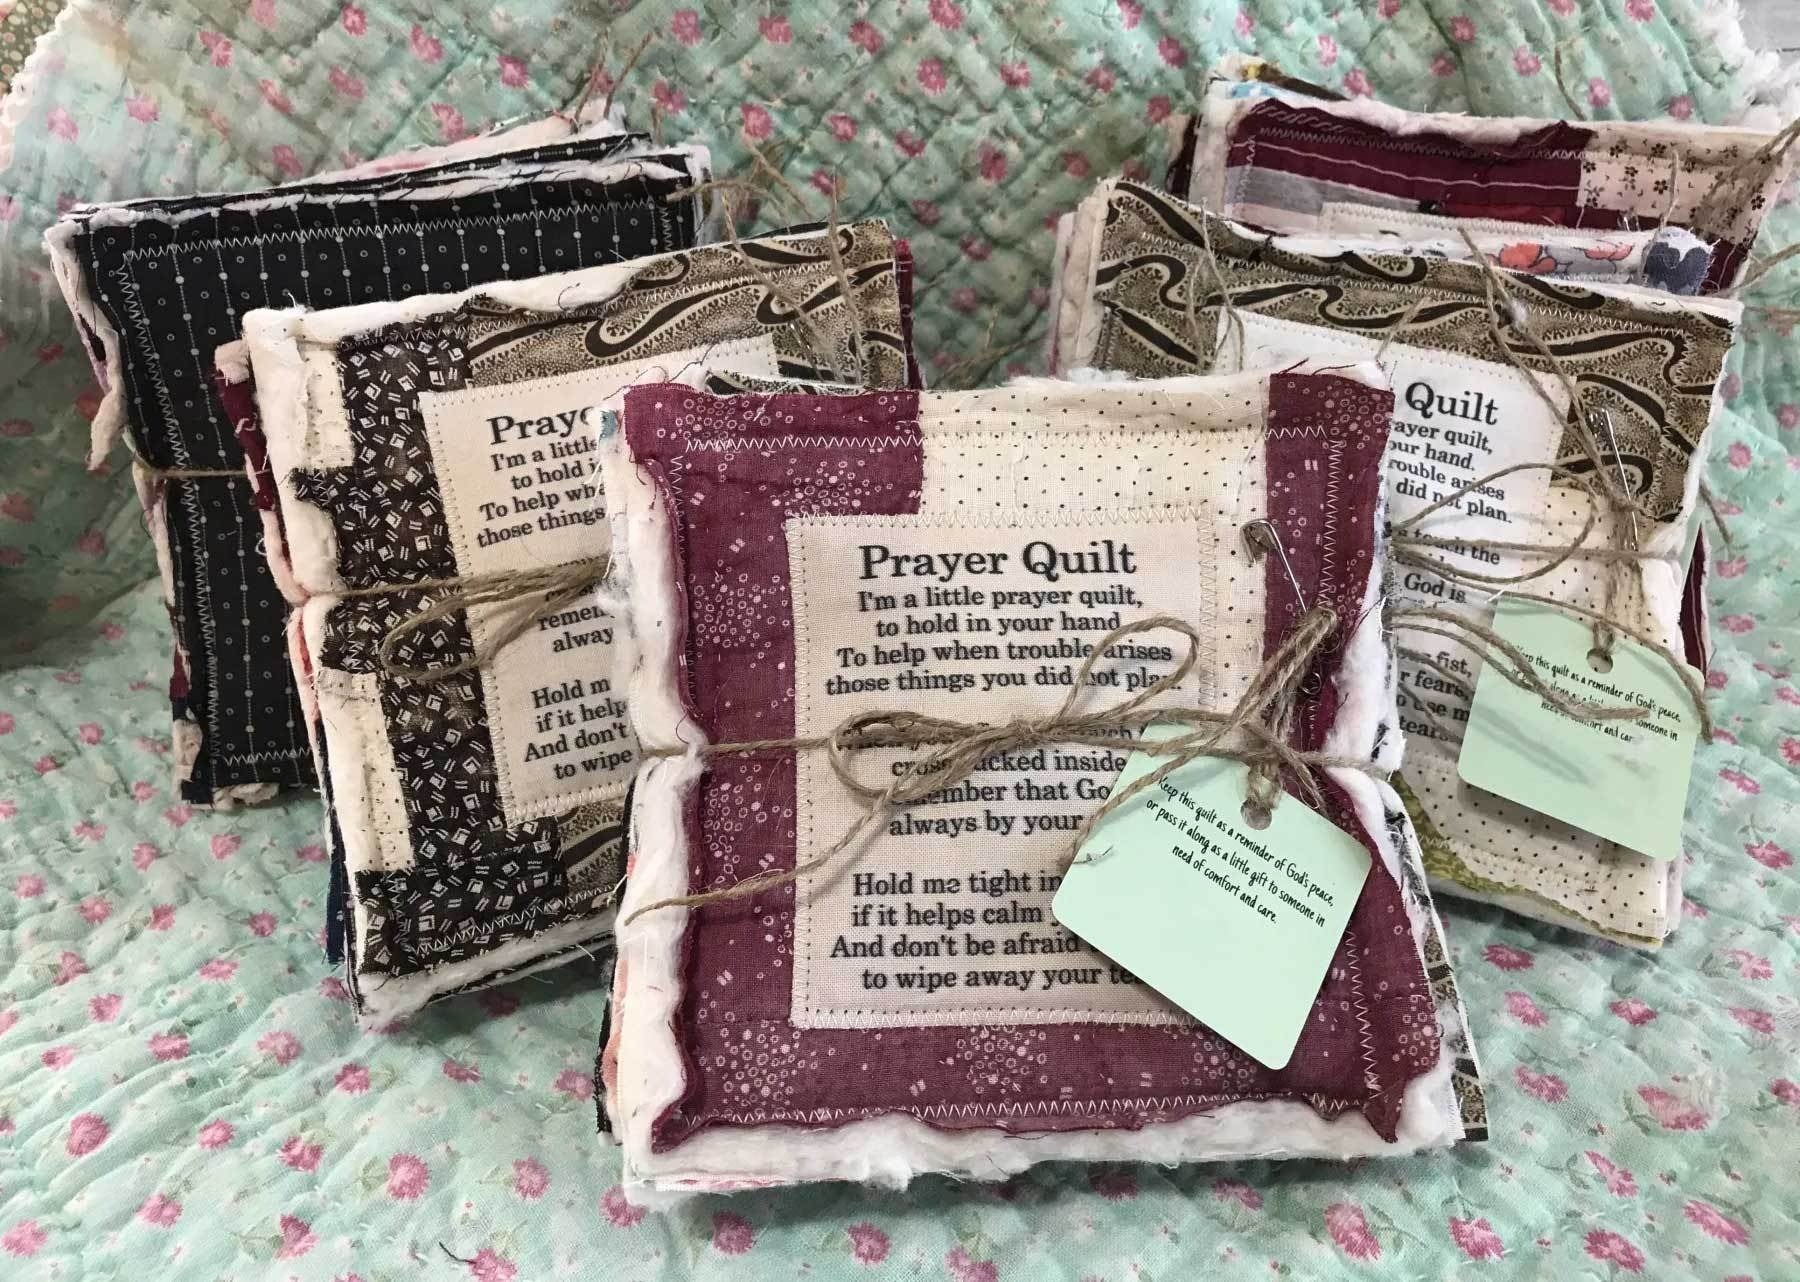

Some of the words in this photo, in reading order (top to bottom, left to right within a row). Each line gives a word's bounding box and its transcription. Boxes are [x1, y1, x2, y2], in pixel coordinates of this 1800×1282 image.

[1405, 382, 1499, 425] Quilt
[1393, 421, 1440, 439] ayer
[1444, 430, 1493, 454] quilt,
[491, 453, 526, 472] I'm
[532, 450, 545, 462] a
[1387, 459, 1446, 484] rouble
[1424, 443, 1475, 471] hand.
[511, 475, 532, 490] to
[536, 460, 584, 483] hold
[480, 502, 508, 521] To
[512, 491, 559, 513] help
[1396, 477, 1427, 499] did
[1466, 499, 1512, 523] plan.
[477, 522, 533, 547] those
[537, 507, 605, 531] things
[859, 544, 1007, 582] Prayer
[1023, 540, 1137, 582] Quilt
[858, 590, 895, 612] I'm
[904, 592, 918, 608] a
[926, 586, 983, 607] little
[991, 588, 1071, 609] prayer
[1079, 585, 1143, 608] quilt,
[1404, 573, 1445, 596] God
[1449, 583, 1466, 603] is
[553, 627, 614, 653] alway
[876, 618, 899, 637] to
[907, 614, 957, 634] hold
[967, 614, 990, 632] in
[998, 618, 1053, 637] your
[837, 647, 866, 668] To
[874, 643, 925, 667] help
[933, 640, 999, 660] when
[1007, 637, 1093, 660] trouble
[1104, 639, 1172, 660] arises
[531, 679, 584, 709] Hold
[826, 676, 889, 695] those
[898, 669, 975, 692] things
[981, 673, 1026, 691] you
[1034, 666, 1073, 686] did
[1536, 656, 1550, 670] this
[1551, 665, 1570, 678] quilt
[1571, 673, 1580, 681] as
[1588, 679, 1623, 698] reminder
[1625, 692, 1634, 702] of
[536, 712, 552, 733] if
[558, 709, 576, 727] it
[579, 697, 627, 722] help
[525, 734, 570, 762] And
[574, 722, 628, 749] don't
[1604, 725, 1618, 738] and
[1670, 731, 1678, 741] in
[553, 763, 576, 779] to
[581, 749, 633, 772] wipe
[1054, 749, 1127, 772] inside
[1014, 779, 1069, 800] that
[1076, 777, 1111, 800] Go
[889, 813, 978, 838] always
[983, 809, 1015, 833] by
[1023, 814, 1083, 834] your
[1158, 777, 1178, 802] Keep
[1178, 791, 1196, 810] this
[1196, 807, 1217, 822] quilt
[1216, 819, 1227, 832] as
[1228, 826, 1234, 837] a
[1234, 832, 1274, 862] reminder
[1274, 858, 1288, 871] of
[1286, 863, 1310, 888] God's
[1307, 883, 1334, 907] peace,
[1146, 799, 1158, 810] or
[1156, 807, 1177, 826] pass
[1178, 819, 1188, 831] it
[1187, 826, 1210, 854] along
[1211, 844, 1222, 856] as
[1222, 852, 1228, 861] a
[1230, 851, 1250, 875] little
[1249, 870, 1268, 886] gift
[1269, 880, 1278, 894] to
[1279, 890, 1314, 920] someone
[1316, 911, 1325, 927] in
[853, 873, 913, 897] Hold
[922, 878, 961, 894] me
[968, 870, 1032, 897] tight
[1172, 845, 1192, 864] need
[1193, 858, 1206, 872] of
[1204, 867, 1240, 896] comfort
[1240, 895, 1258, 908] and
[1257, 903, 1277, 923] care.
[851, 904, 874, 927] if
[878, 904, 898, 926] it
[904, 902, 975, 929] helps
[982, 901, 1043, 924] calm
[830, 935, 884, 958] And
[891, 935, 957, 958] don't
[965, 933, 995, 956] be
[1000, 930, 1080, 954] afraid
[862, 970, 887, 989] to
[894, 967, 957, 993] wipe
[964, 969, 1035, 991] away
[1042, 967, 1103, 991] your
